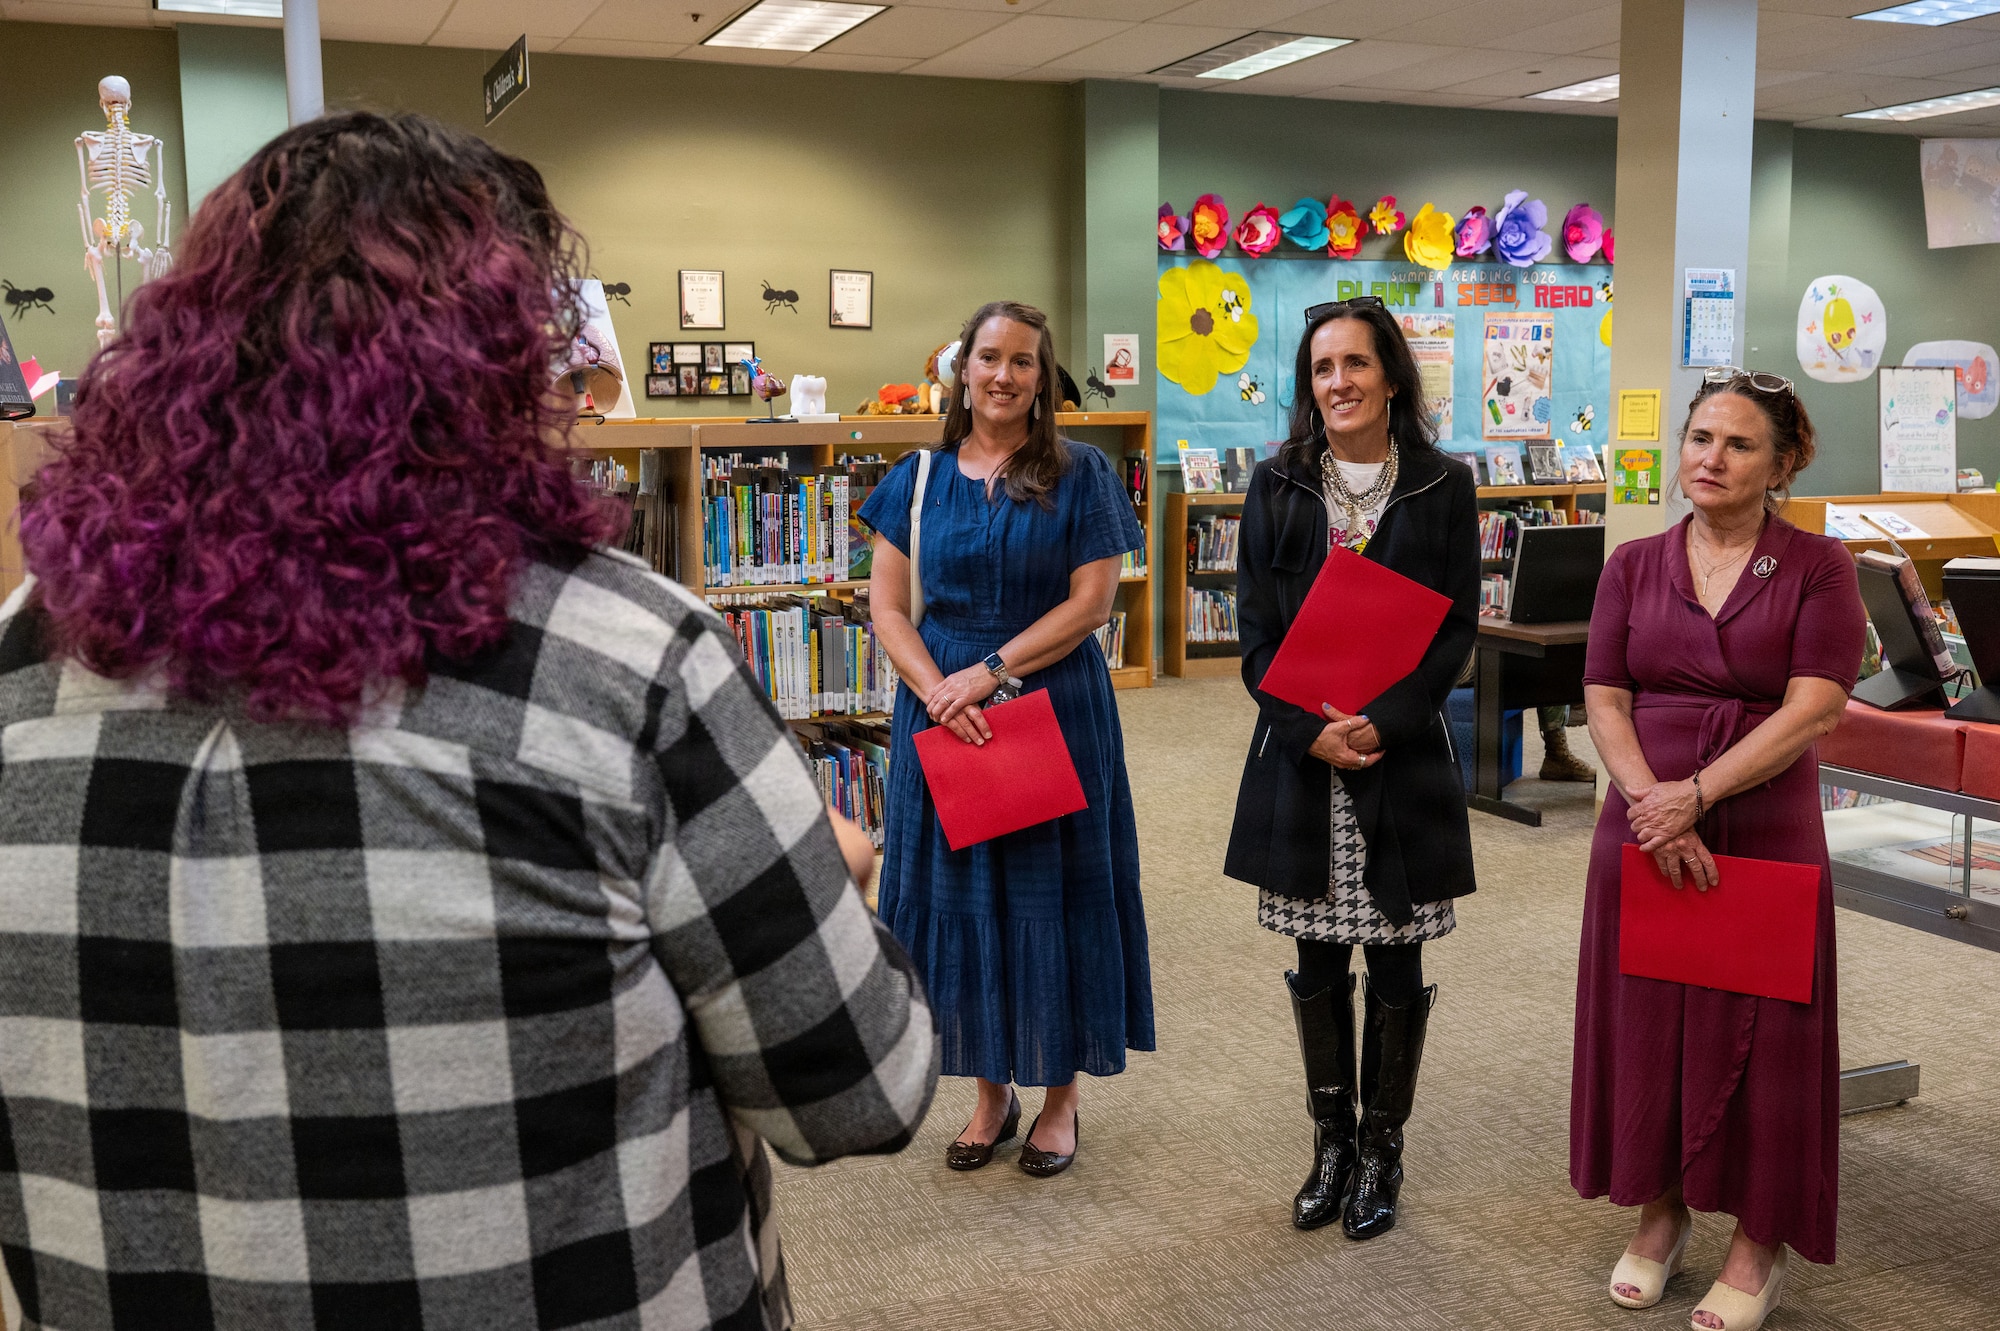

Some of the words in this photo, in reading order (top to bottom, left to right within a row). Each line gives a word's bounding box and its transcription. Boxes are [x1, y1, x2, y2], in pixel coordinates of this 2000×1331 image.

[1390, 270, 1444, 282] SUMMER
[1451, 269, 1512, 282] READING
[1522, 271, 1557, 284] 2026
[1434, 282, 1444, 308] A
[1457, 283, 1520, 310] SEED,
[1535, 285, 1593, 308] READ
[1900, 382, 1930, 393] SILENT
[1134, 489, 1141, 506] Q
[1504, 547, 1512, 559] U
[1188, 560, 1194, 573] S
